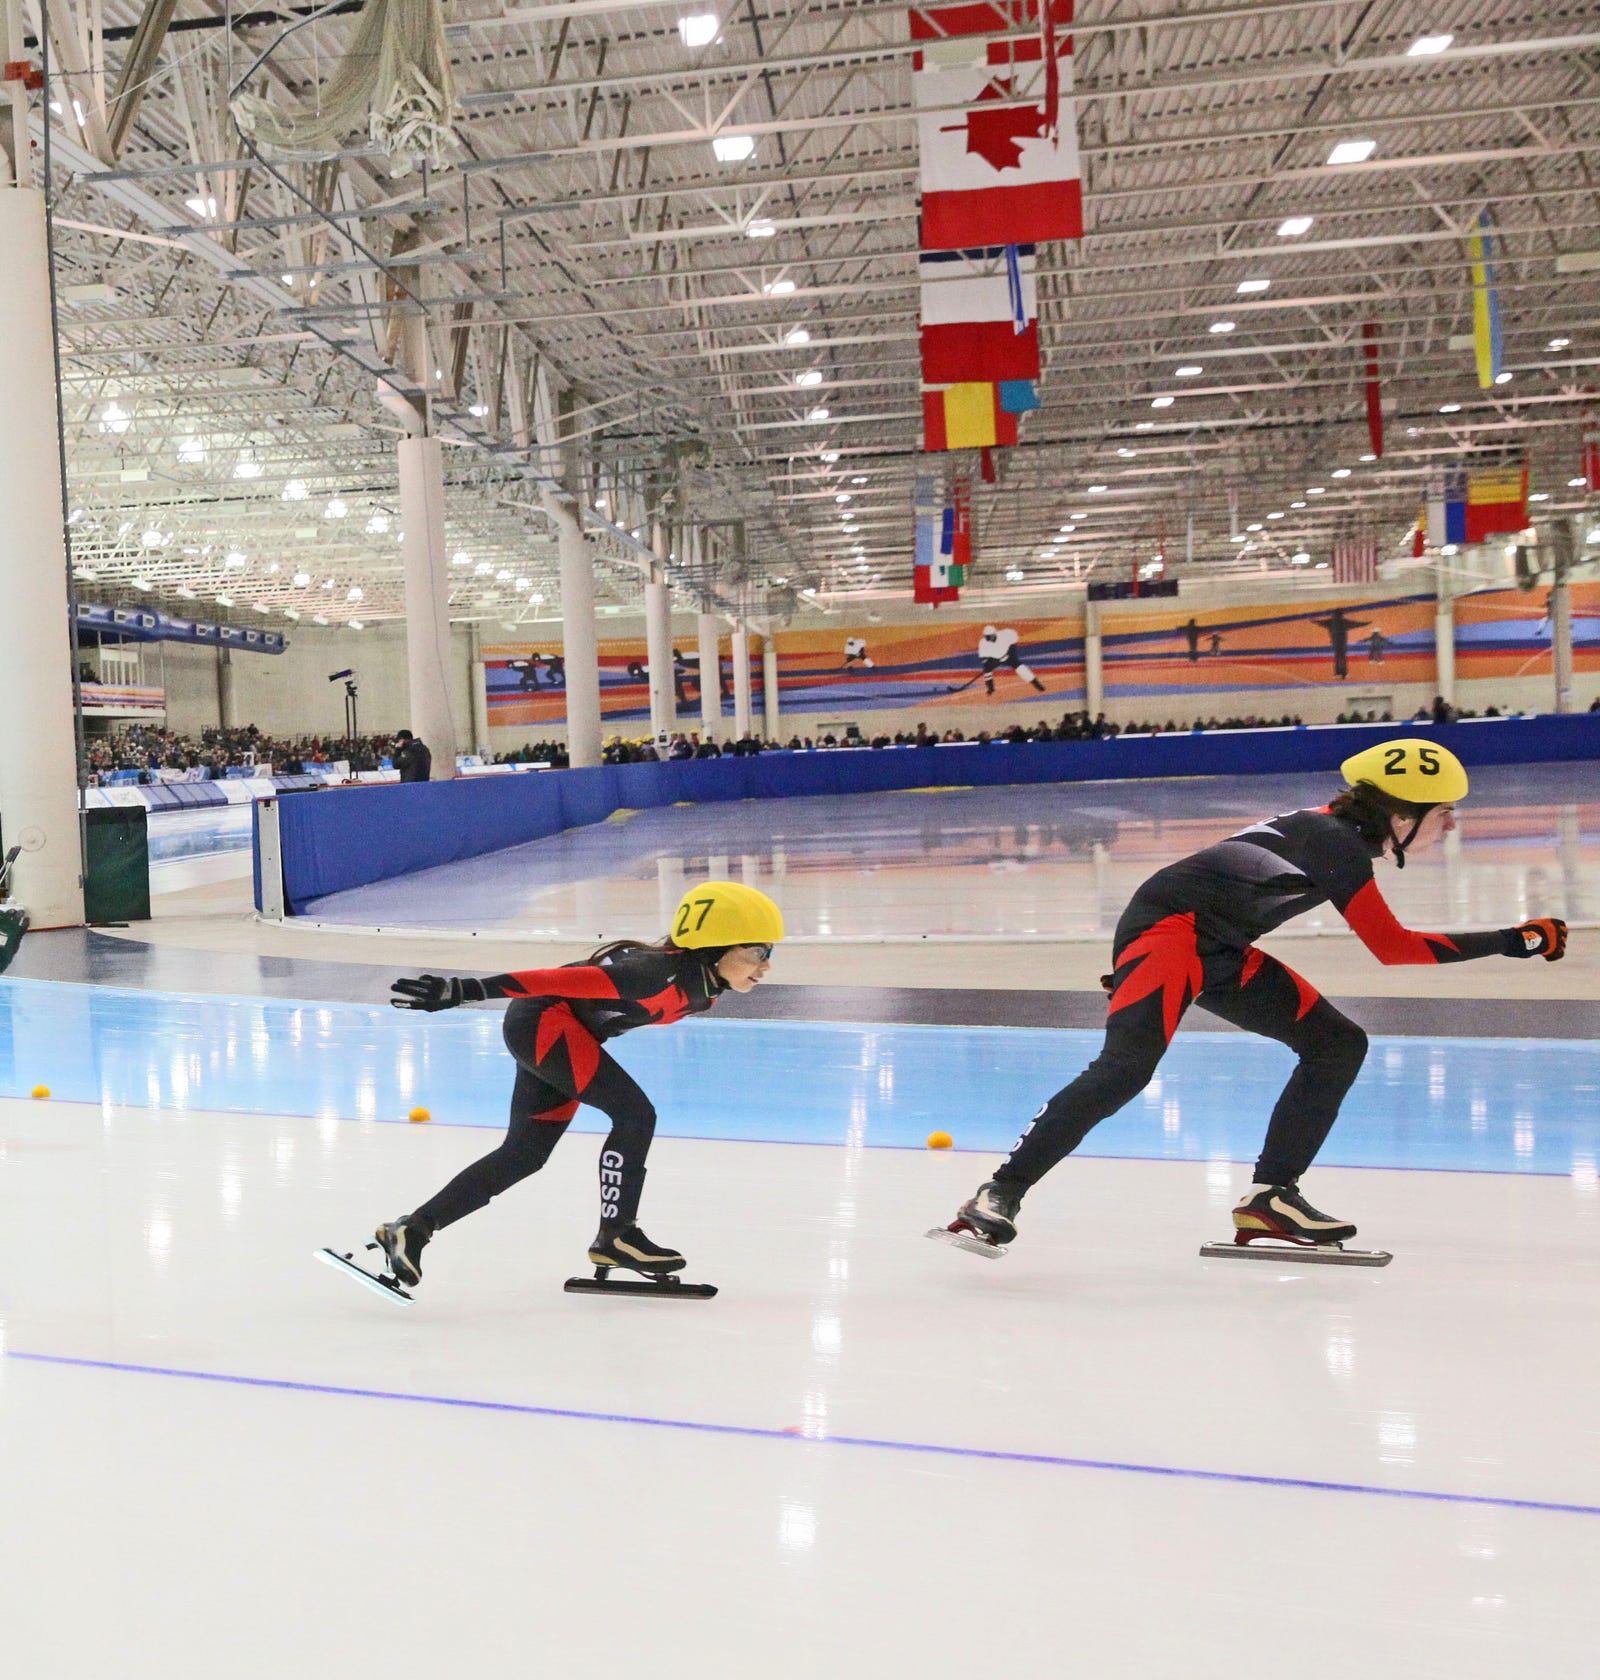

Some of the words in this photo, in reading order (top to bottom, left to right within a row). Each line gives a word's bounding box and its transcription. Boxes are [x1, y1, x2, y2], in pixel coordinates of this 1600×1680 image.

[1384, 747, 1441, 776] 25
[676, 898, 716, 937] 27
[601, 1149, 624, 1219] GESS
